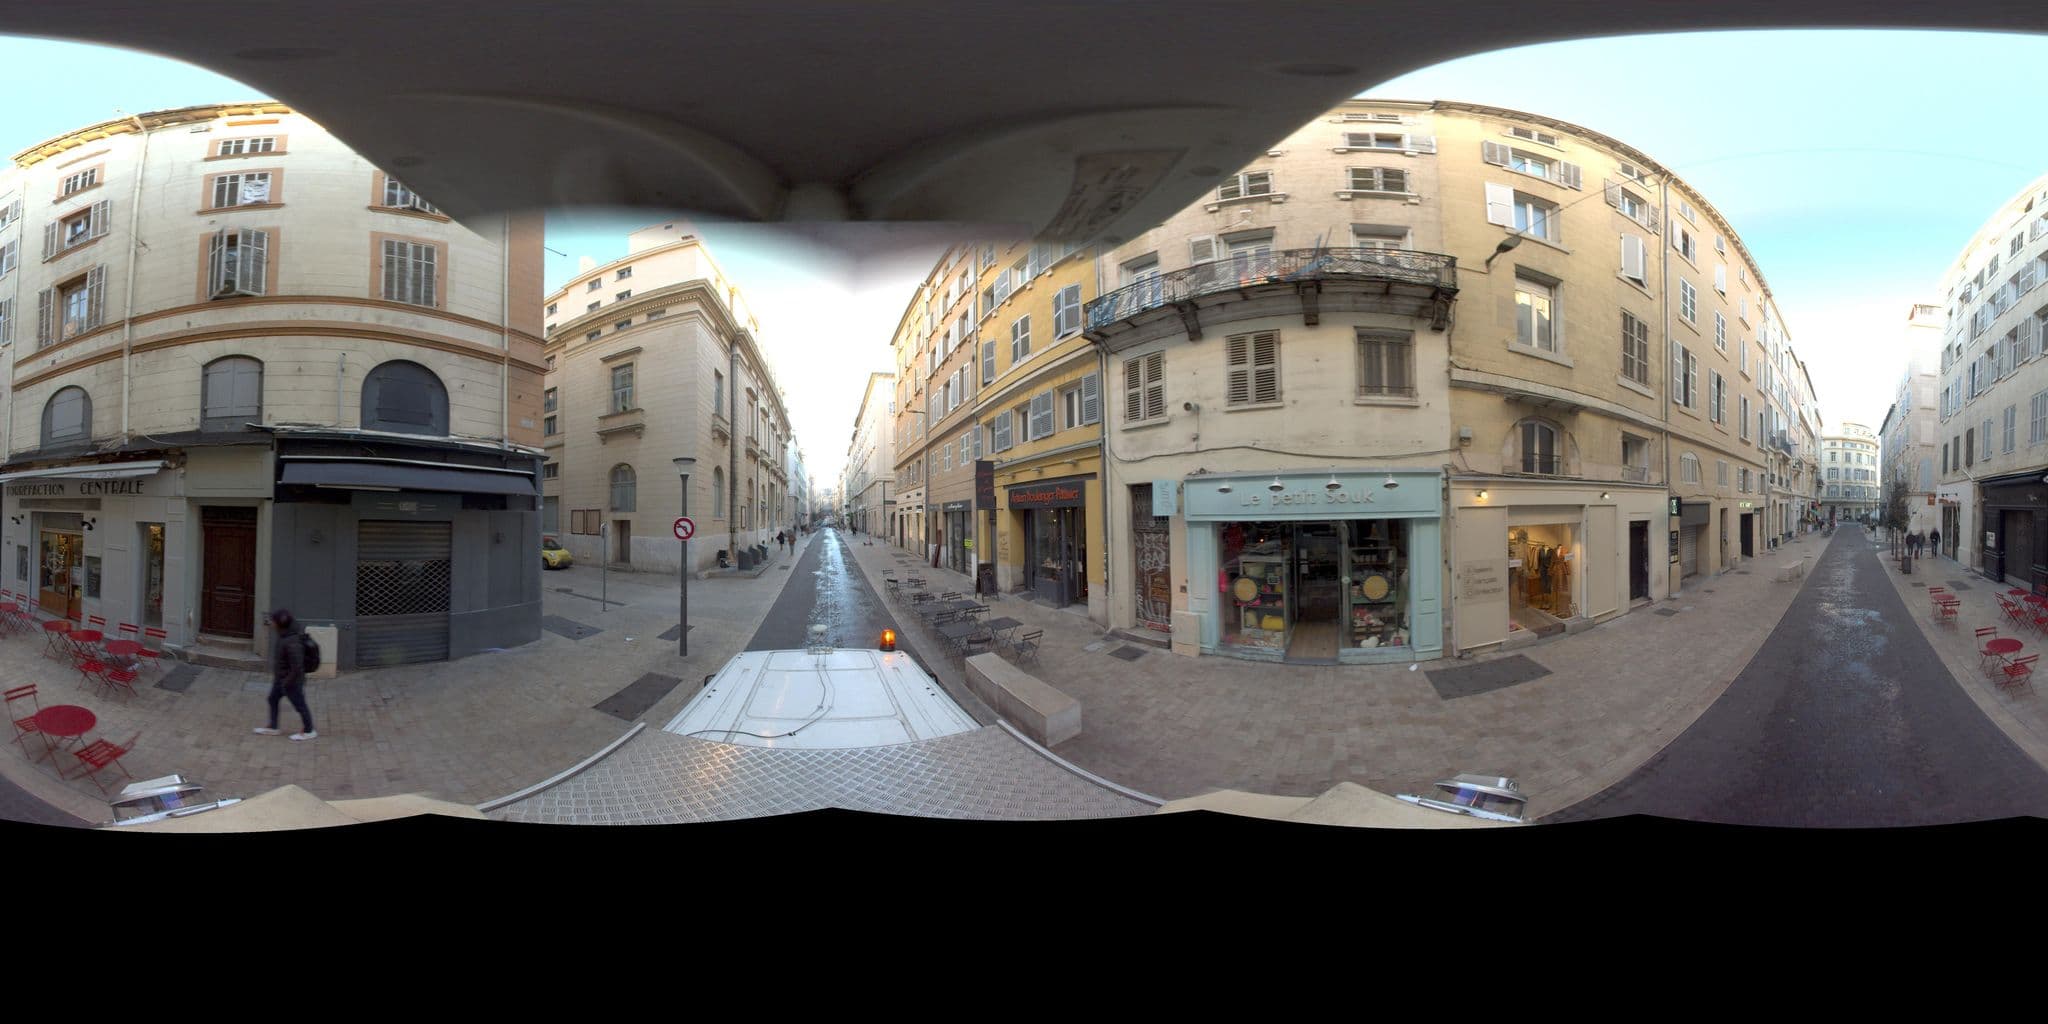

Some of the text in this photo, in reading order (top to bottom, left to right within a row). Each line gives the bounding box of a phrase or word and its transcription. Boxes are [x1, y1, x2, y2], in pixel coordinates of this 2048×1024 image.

[80, 480, 144, 495] CENTRALE
[1240, 487, 1375, 507] Le petit Souk
